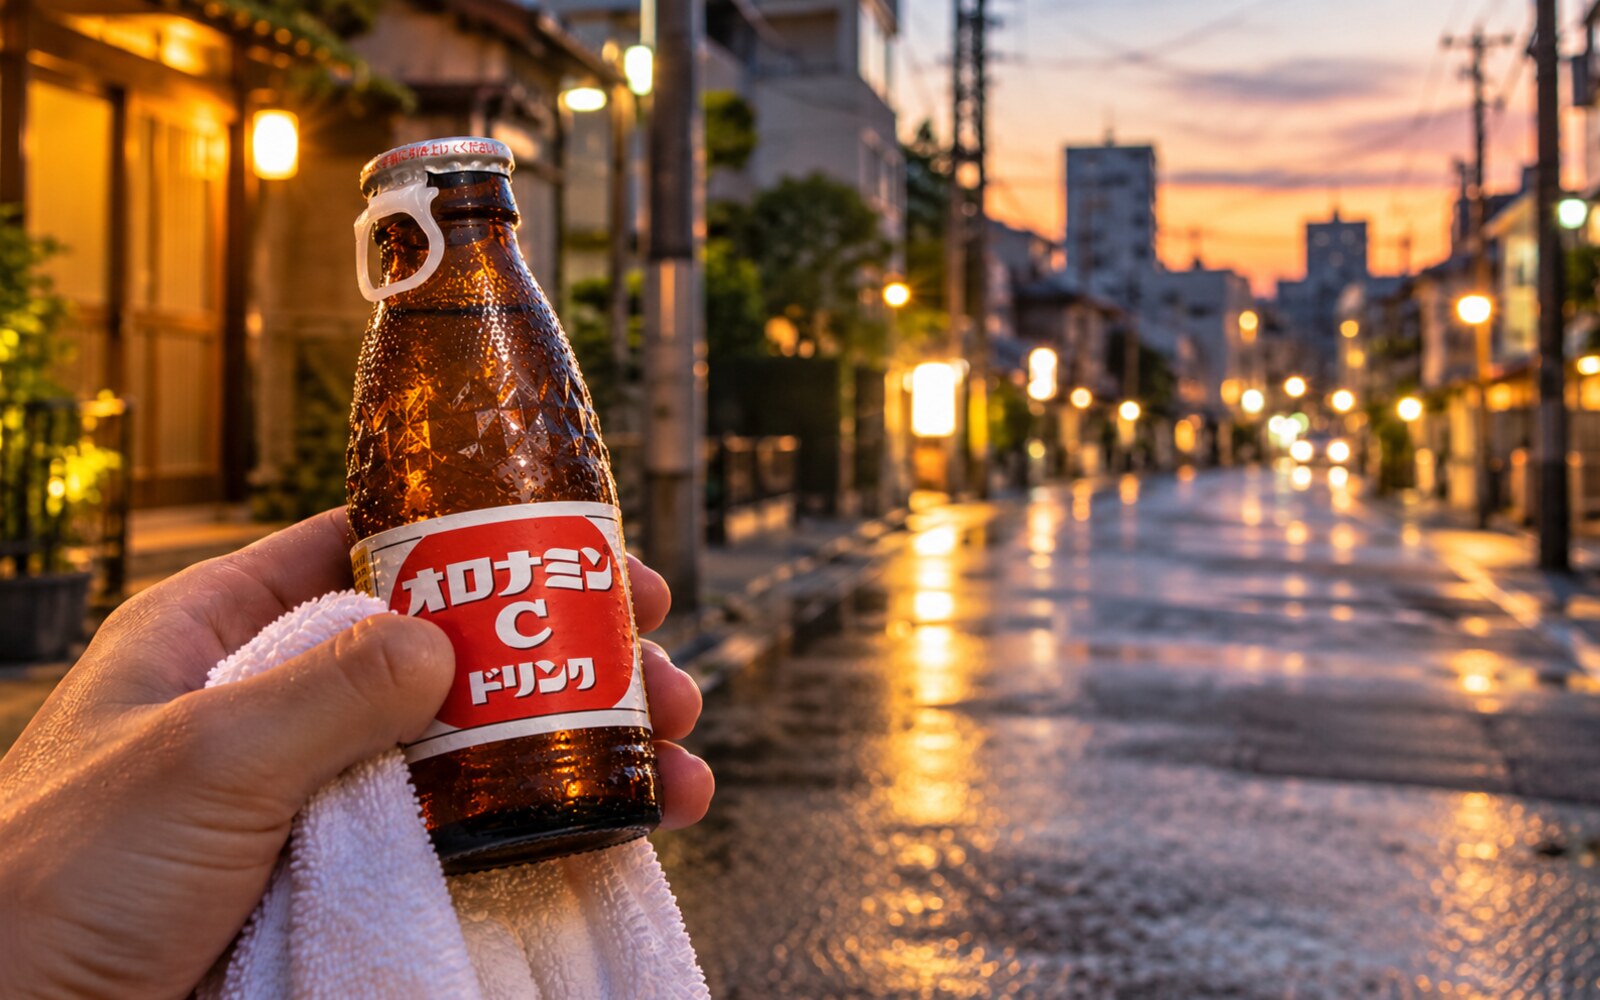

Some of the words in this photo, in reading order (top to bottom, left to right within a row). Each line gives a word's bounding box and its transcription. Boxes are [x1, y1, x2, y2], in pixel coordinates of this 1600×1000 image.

[402, 547, 613, 616] オロナミン
[495, 599, 553, 649] C
[469, 657, 596, 705] ドリンク
